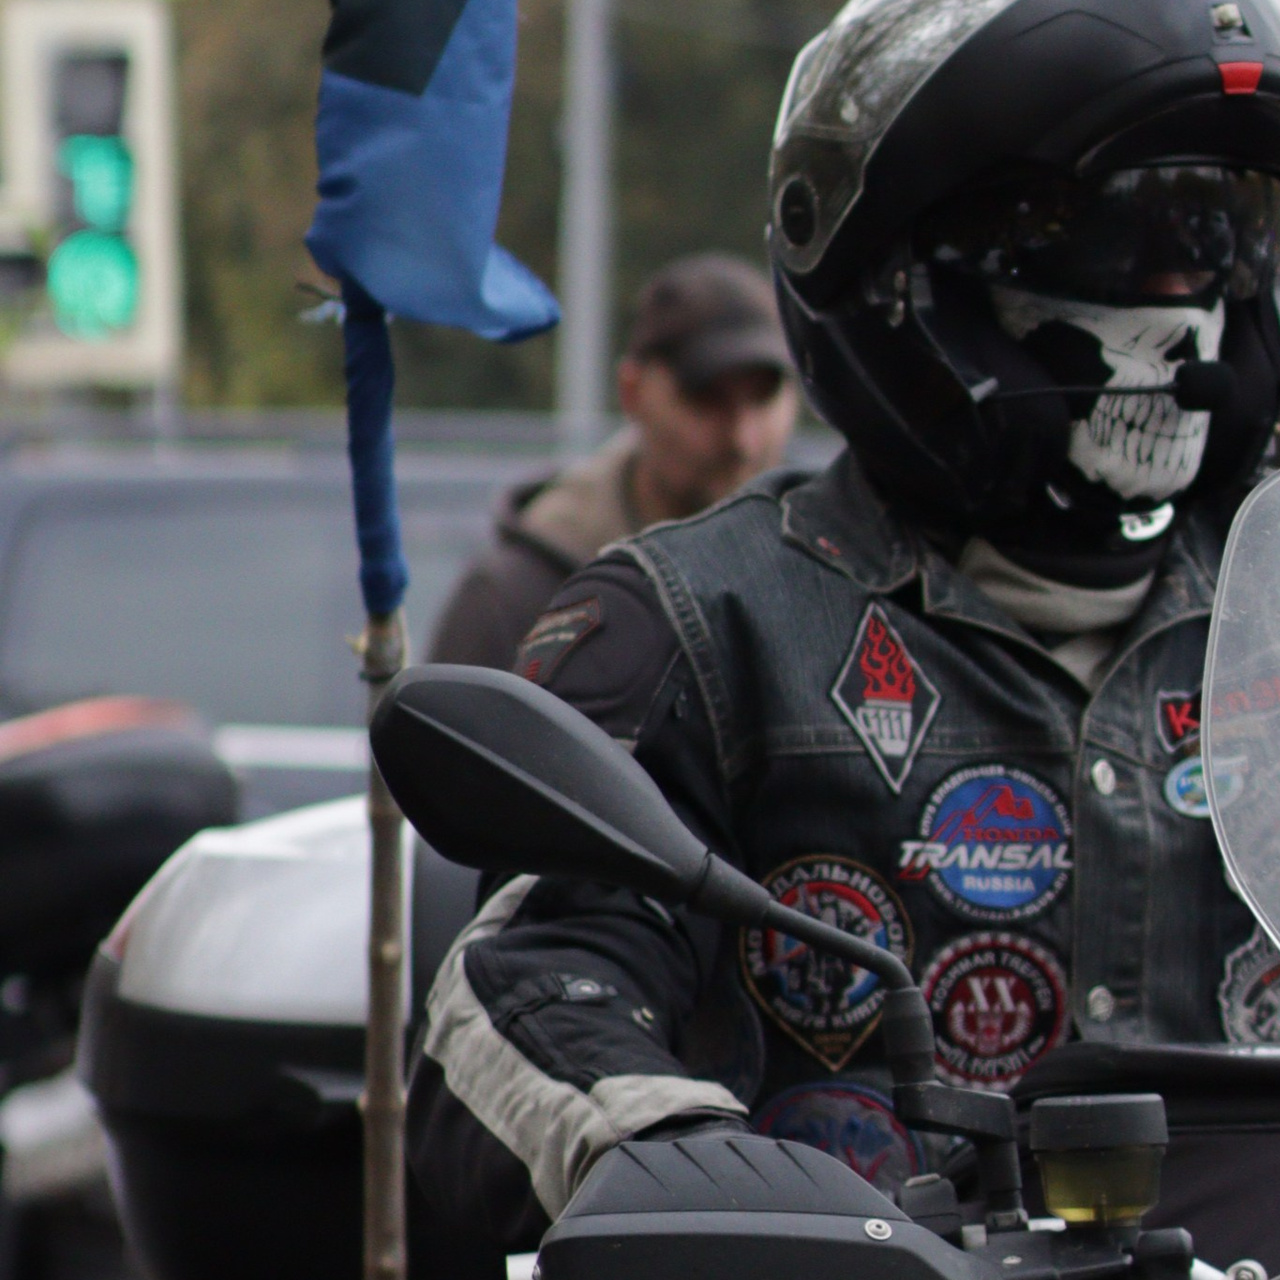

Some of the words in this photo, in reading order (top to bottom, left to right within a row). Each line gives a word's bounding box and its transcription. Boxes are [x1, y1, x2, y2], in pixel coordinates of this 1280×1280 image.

[963, 826, 1060, 842] HONDA
[899, 840, 1074, 870] TRANSAL
[963, 875, 1036, 891] RUSSIA
